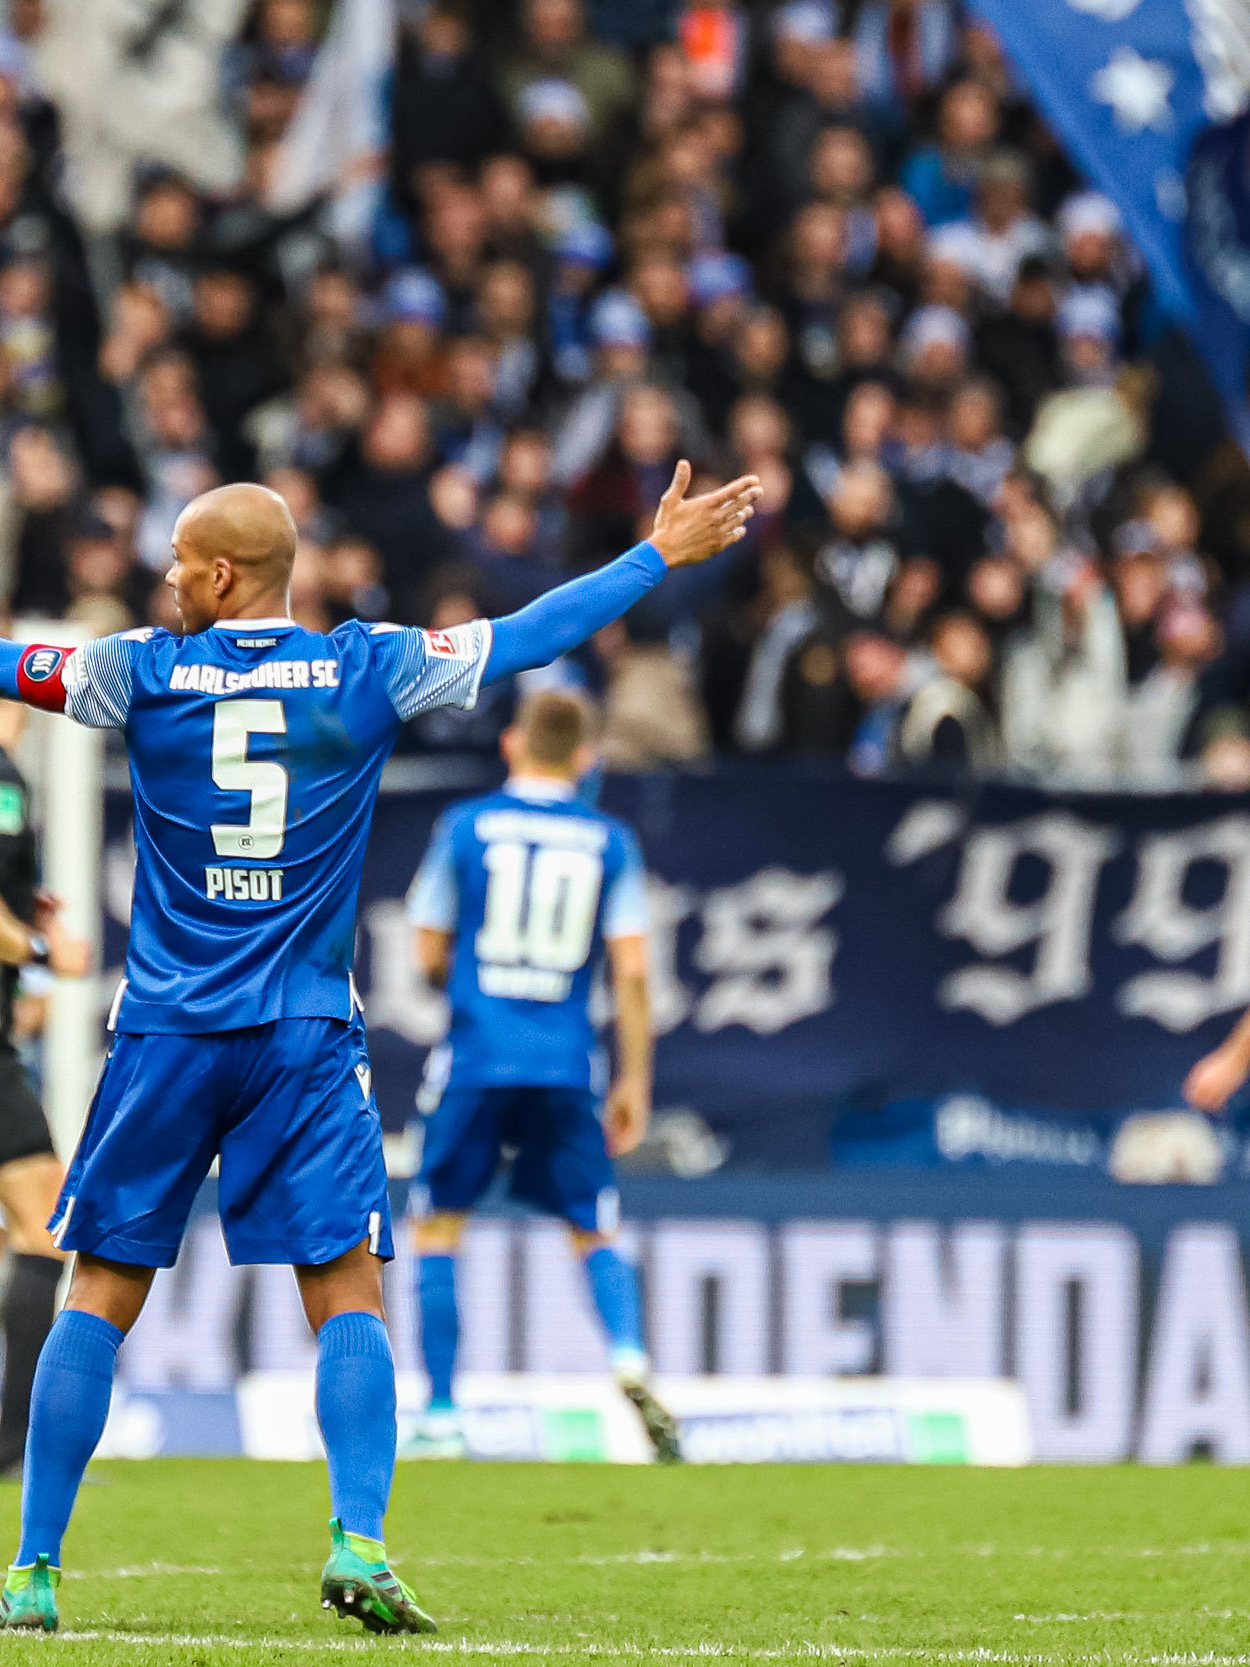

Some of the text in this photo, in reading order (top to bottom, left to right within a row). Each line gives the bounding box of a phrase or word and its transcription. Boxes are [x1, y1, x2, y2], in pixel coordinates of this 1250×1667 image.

[311, 658, 340, 689] SC
[211, 698, 289, 859] 5
[205, 867, 284, 901] PISOT
[474, 842, 603, 972] 10
